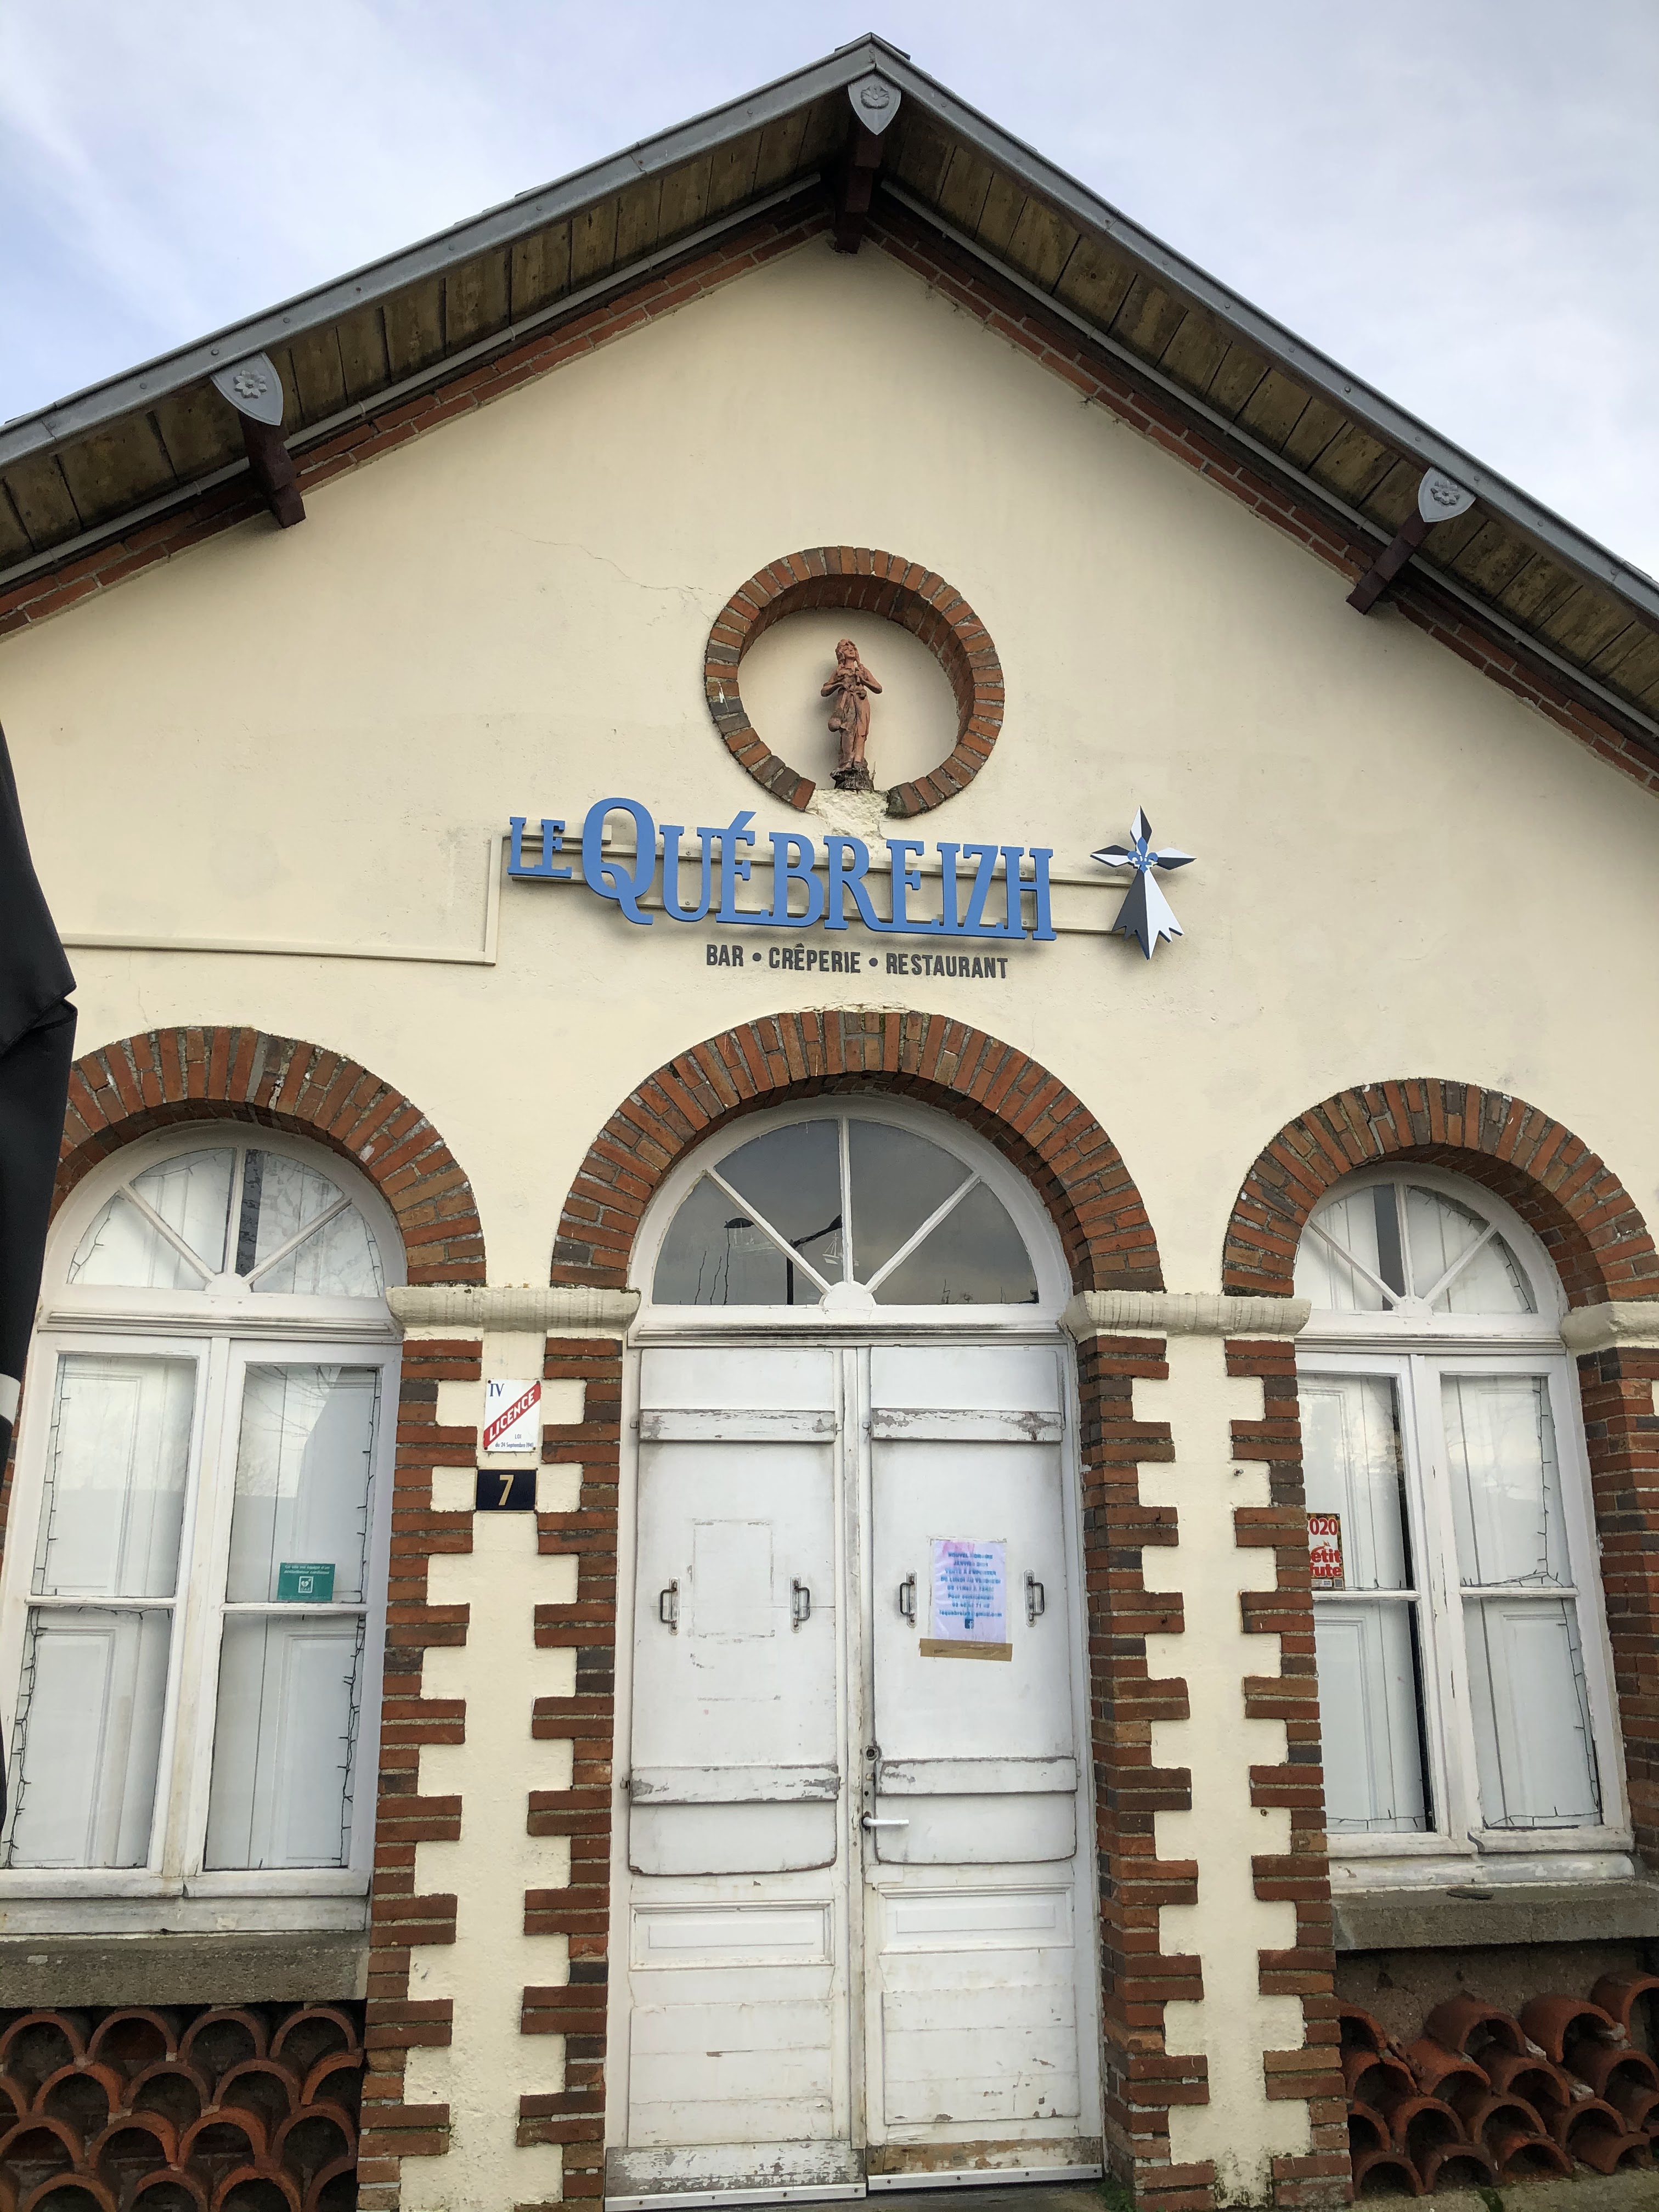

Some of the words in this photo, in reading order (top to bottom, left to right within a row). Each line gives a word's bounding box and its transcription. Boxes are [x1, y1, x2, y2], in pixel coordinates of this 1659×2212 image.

[507, 816, 572, 878] LE
[582, 797, 1057, 941] QUÉBREIZH
[706, 944, 744, 967] BAR
[769, 943, 861, 974] CRÊPERIE
[885, 952, 1008, 978] RESTAURANT
[489, 1383, 505, 1397] IV
[489, 1389, 535, 1441] LICENCE
[498, 1475, 514, 1506] 7
[1308, 1517, 1338, 1536] 020
[1310, 1548, 1342, 1563] etit
